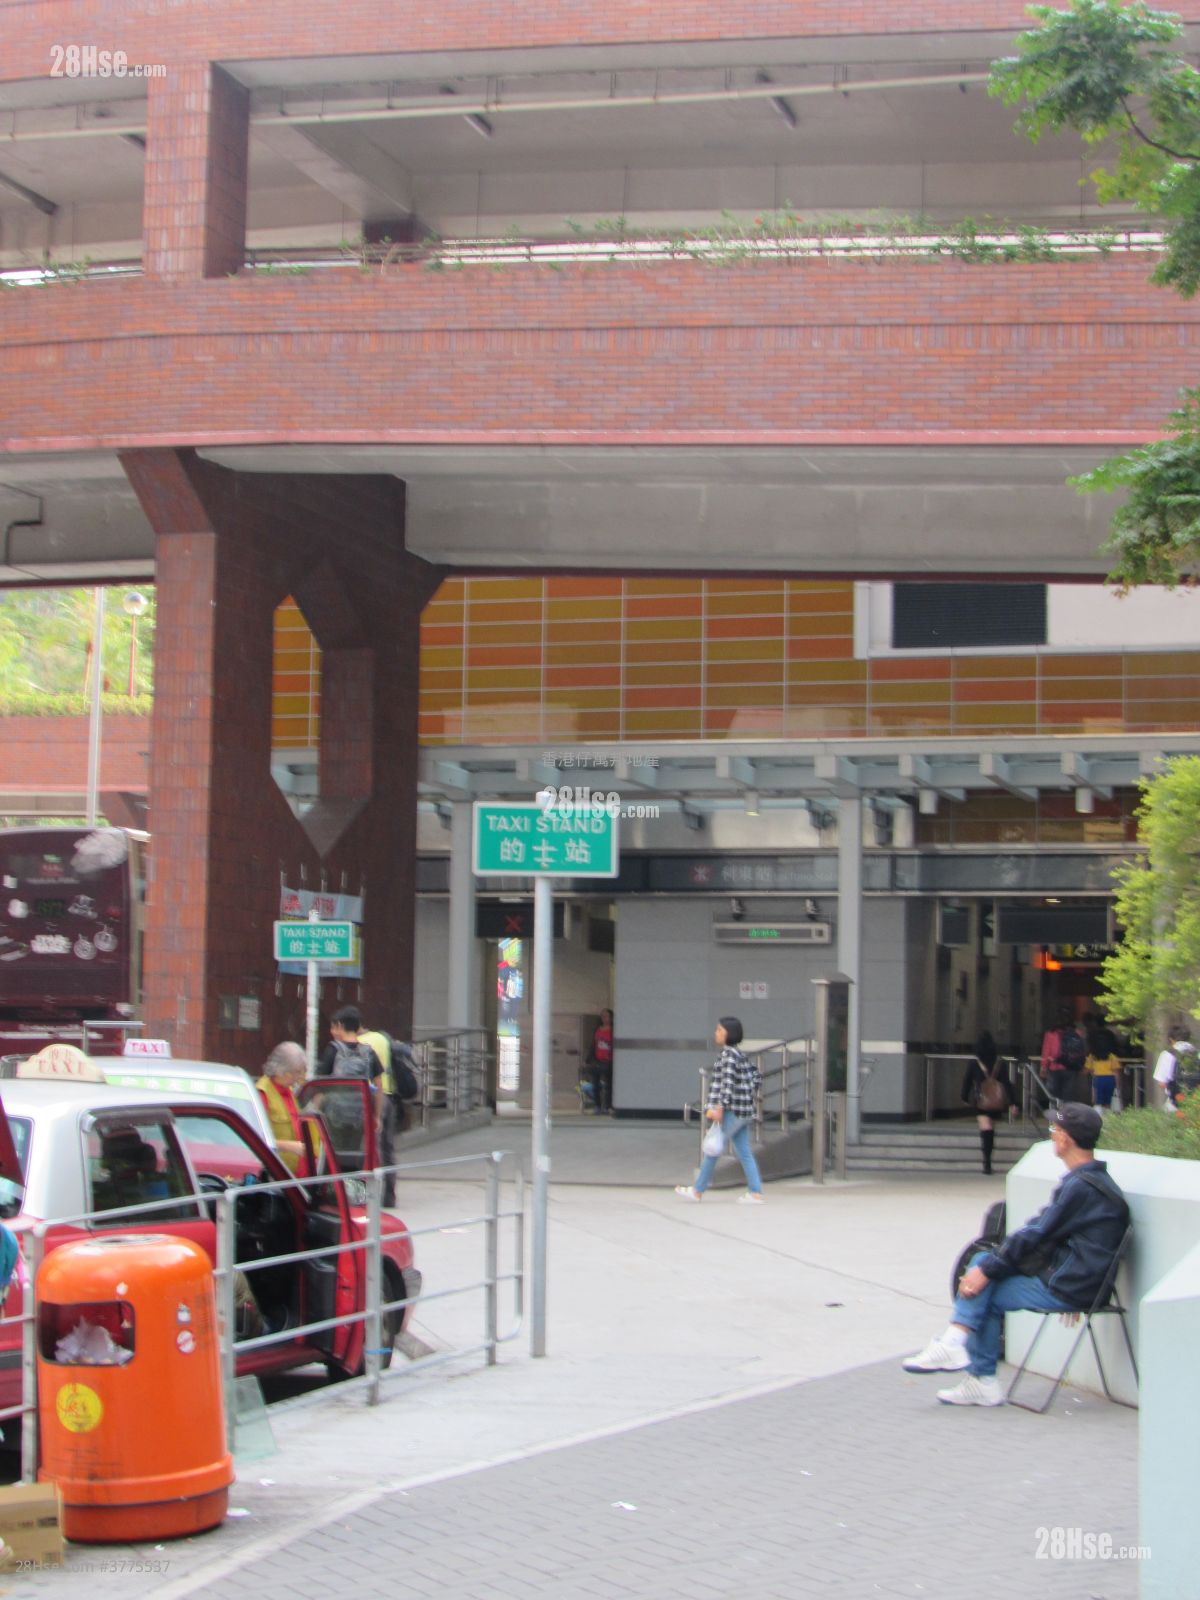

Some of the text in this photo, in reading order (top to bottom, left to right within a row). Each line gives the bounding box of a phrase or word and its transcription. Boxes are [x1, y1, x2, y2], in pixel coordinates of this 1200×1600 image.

[486, 814, 607, 834] TAXI STAND
[500, 837, 592, 868] 的士站
[282, 928, 346, 938] TAXI STAND
[289, 940, 341, 954] 的士站
[130, 1042, 166, 1053] TAXI
[38, 1058, 86, 1075] TAXI
